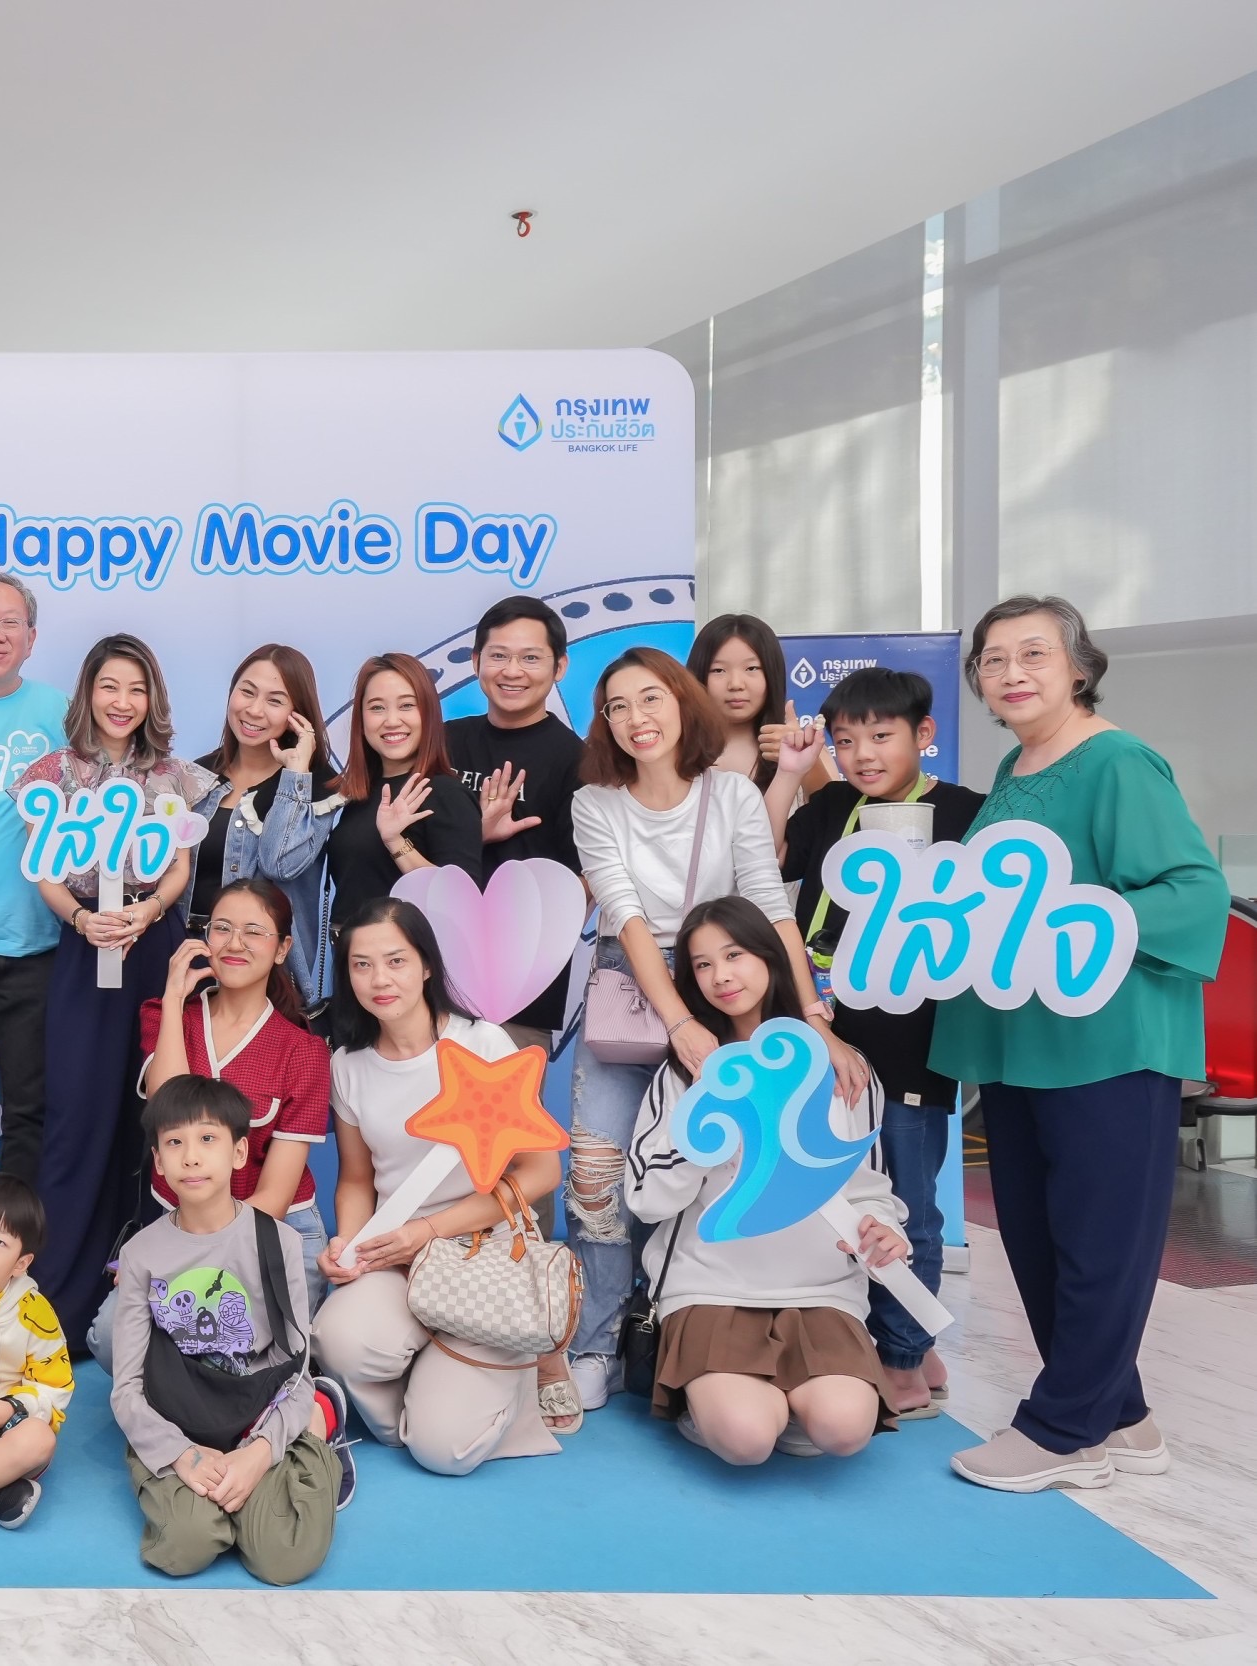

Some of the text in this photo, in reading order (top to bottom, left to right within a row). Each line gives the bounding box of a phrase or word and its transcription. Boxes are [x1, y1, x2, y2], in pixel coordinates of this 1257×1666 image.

[550, 418, 655, 438] ประกันชีวิต
[555, 398, 651, 422] กรุงเทพ
[568, 444, 638, 453] BANGKOK LIFE
[200, 508, 392, 566] Movie
[424, 511, 548, 580] Day
[23, 784, 170, 877] ใส่ใจ
[841, 838, 1115, 998] ใส่ใจ
